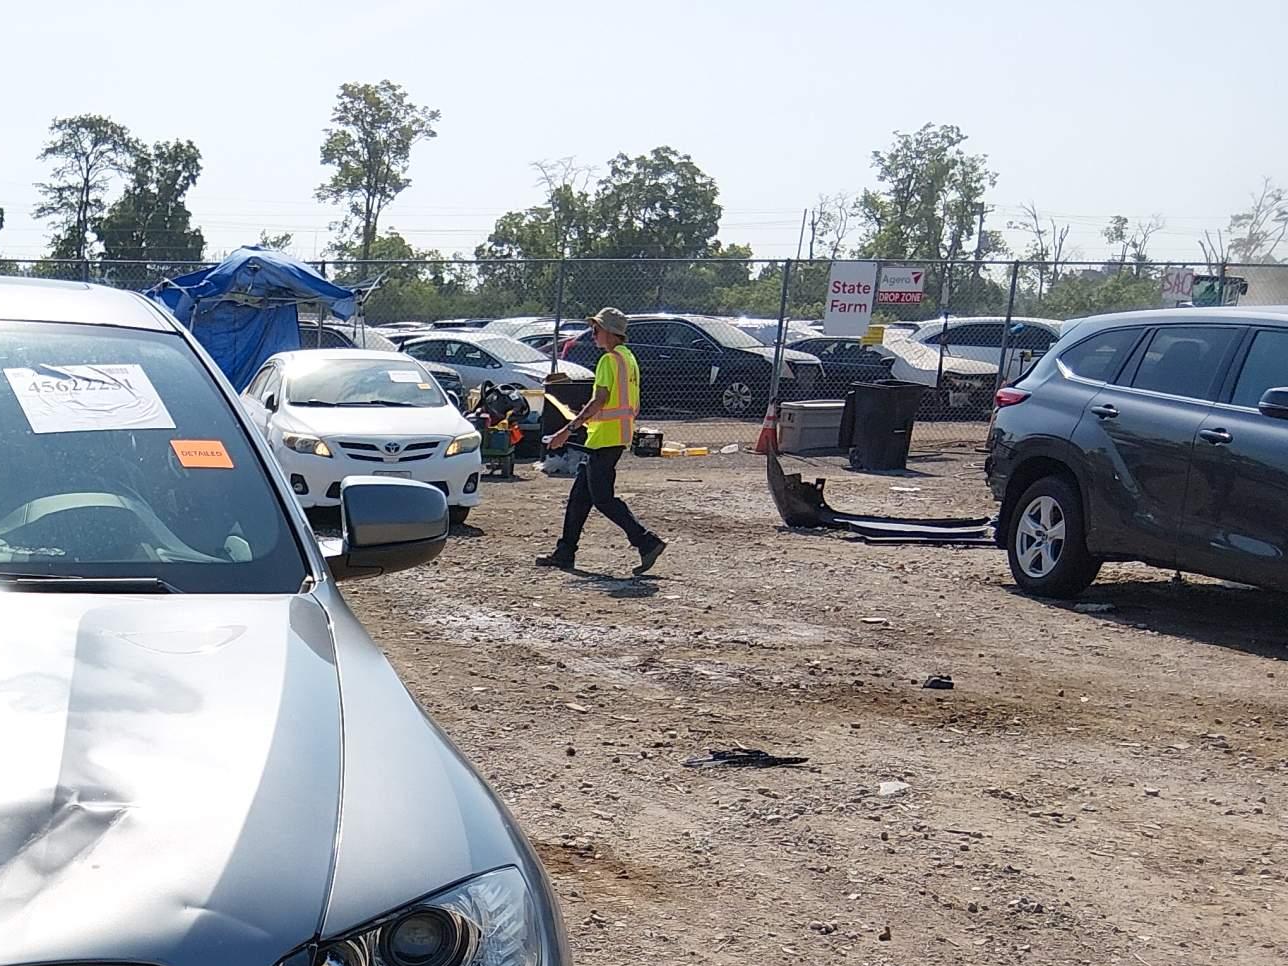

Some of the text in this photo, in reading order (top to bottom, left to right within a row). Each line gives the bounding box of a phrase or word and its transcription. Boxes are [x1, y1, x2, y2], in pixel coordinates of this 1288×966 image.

[882, 275, 910, 286] Agero
[831, 280, 872, 295] State
[878, 292, 922, 302] DROP ZONE
[830, 299, 868, 313] Farm
